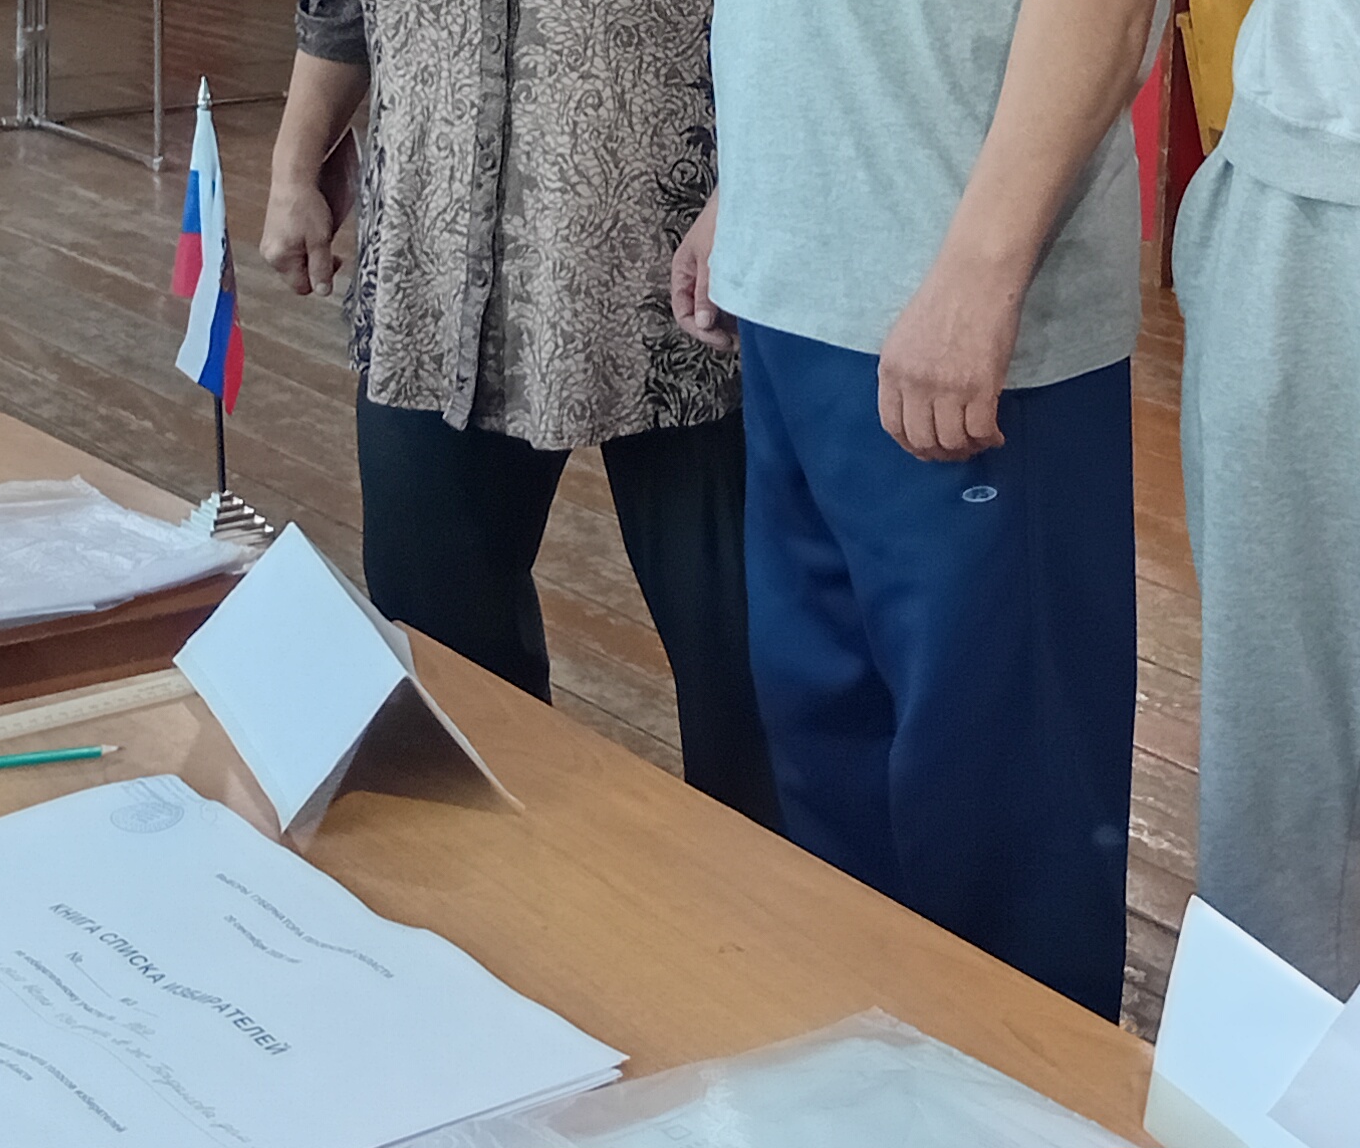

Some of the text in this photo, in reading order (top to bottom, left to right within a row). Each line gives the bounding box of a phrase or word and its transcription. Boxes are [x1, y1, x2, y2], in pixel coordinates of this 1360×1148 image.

[48, 903, 103, 935] КНИГА
[98, 932, 166, 985] СПИСКА
[161, 981, 291, 1056] ИЗБИРАТЕЛЕЙ
